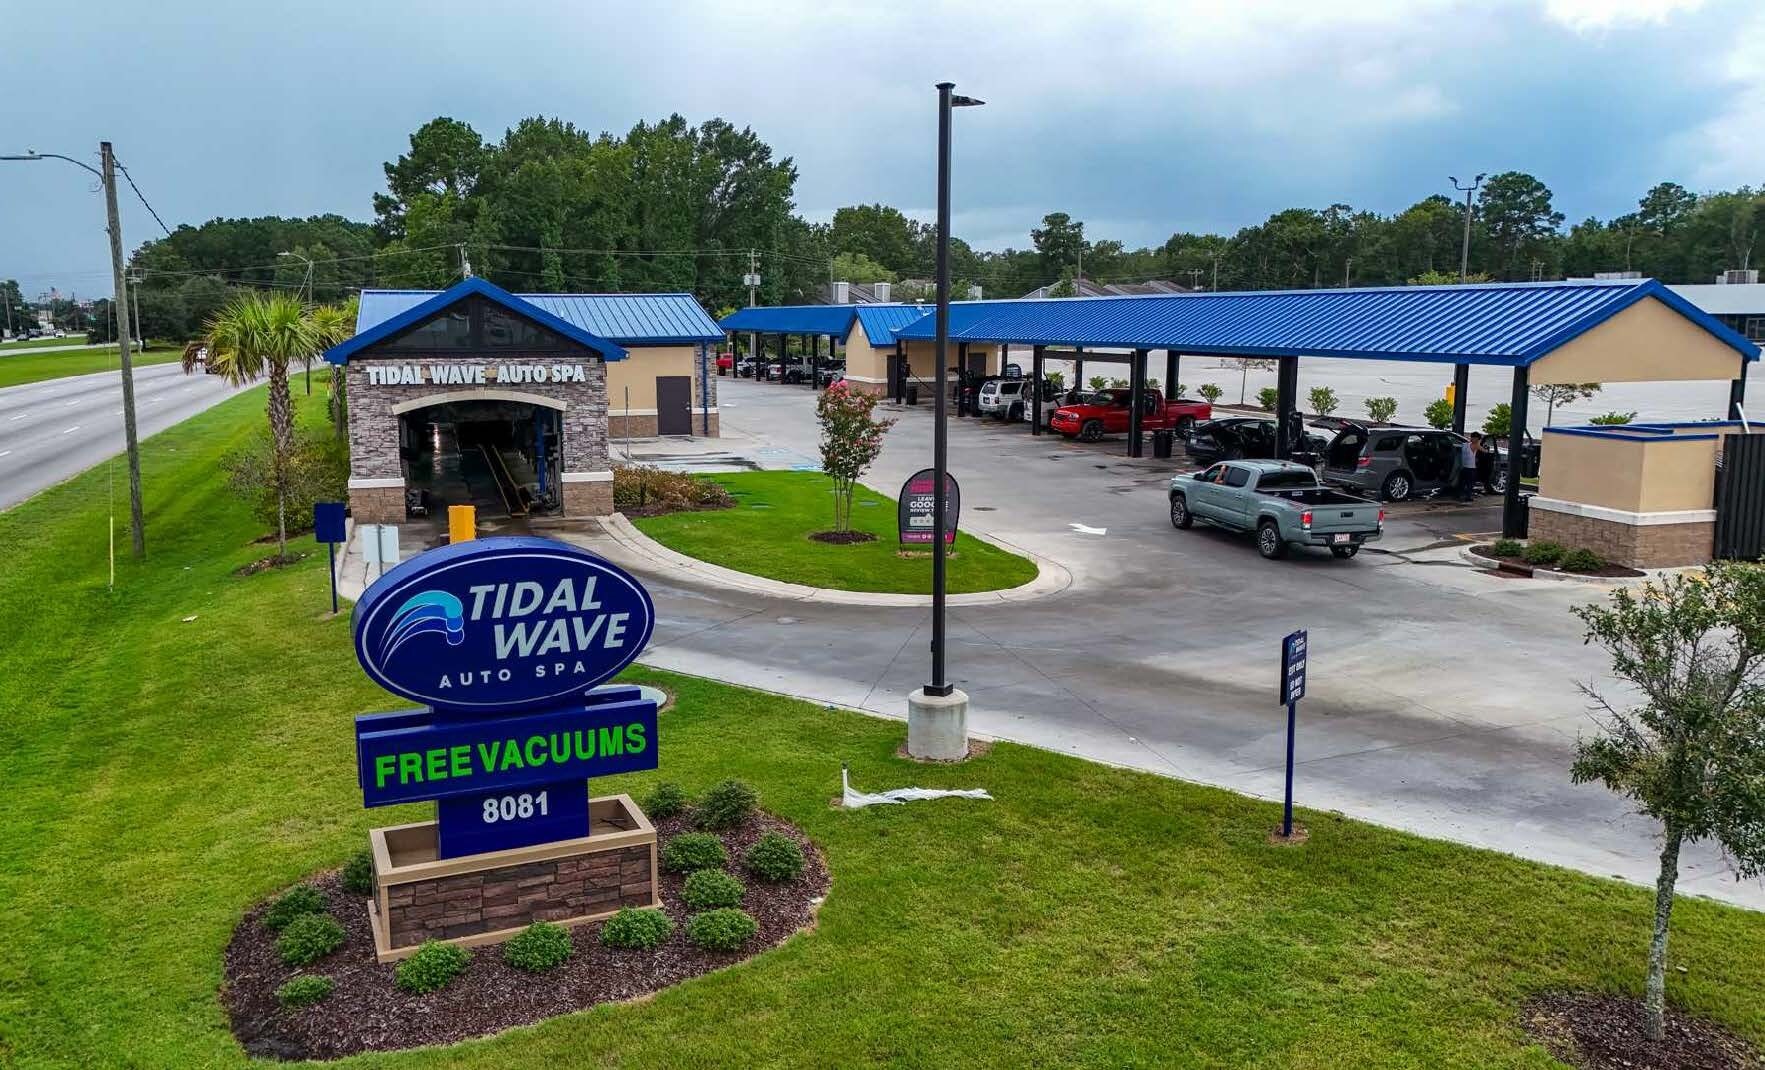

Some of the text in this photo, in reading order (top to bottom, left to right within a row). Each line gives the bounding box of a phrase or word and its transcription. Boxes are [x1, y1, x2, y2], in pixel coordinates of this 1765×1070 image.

[366, 364, 586, 385] TIDAL WAVE AUTO SPA
[468, 576, 602, 621] TIDAL
[493, 612, 630, 660] WAVE
[439, 661, 585, 689] AUTO SPA
[375, 723, 647, 788] FREE VACUUMS
[482, 791, 549, 824] 8081
